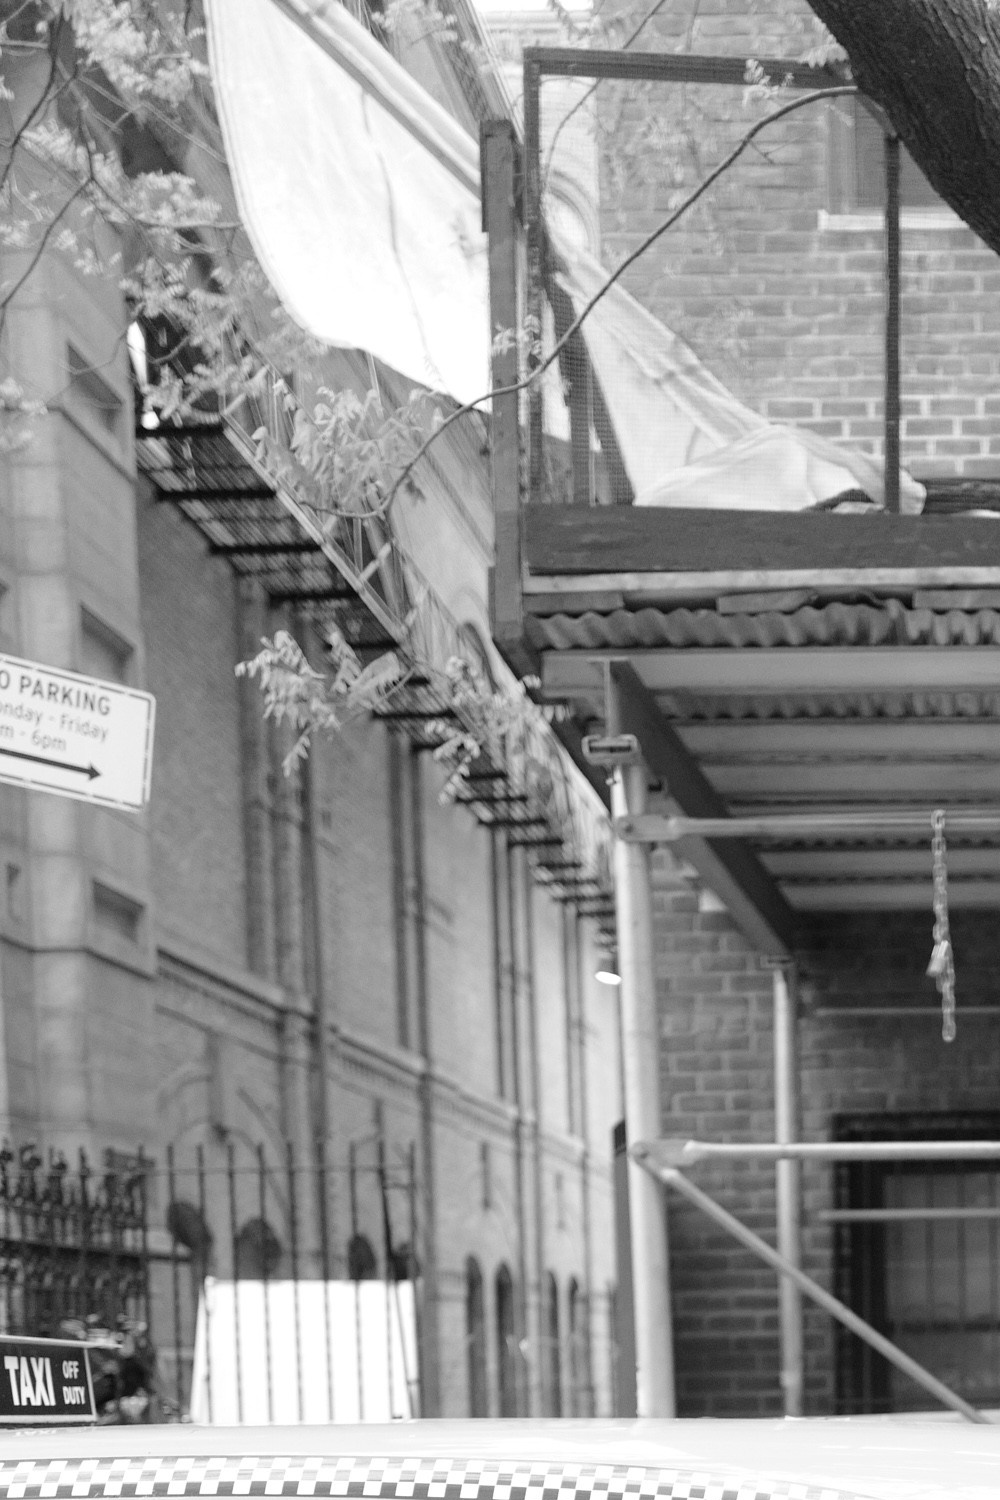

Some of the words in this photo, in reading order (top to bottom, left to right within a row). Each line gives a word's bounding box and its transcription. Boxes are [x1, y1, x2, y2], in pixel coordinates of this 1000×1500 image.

[20, 675, 111, 716] PARKING
[60, 713, 109, 741] Friday
[32, 729, 67, 750] 6pm
[4, 1355, 56, 1407] TAXI
[62, 1360, 79, 1379] OFF
[62, 1386, 85, 1405] DUTY
